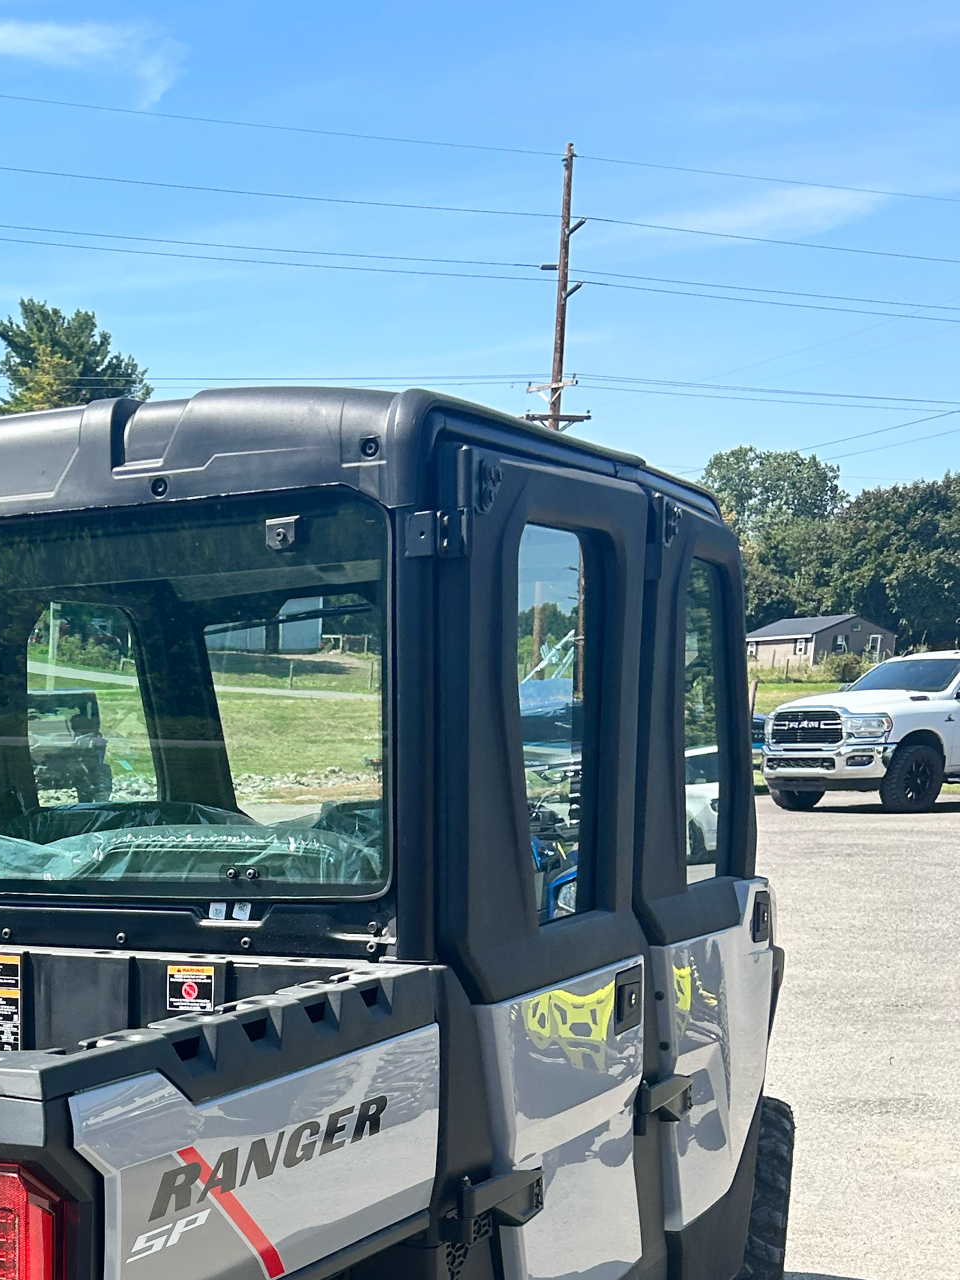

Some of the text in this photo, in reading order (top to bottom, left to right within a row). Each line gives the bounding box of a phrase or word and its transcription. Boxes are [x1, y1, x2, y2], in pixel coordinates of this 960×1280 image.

[788, 720, 819, 729] RAM
[148, 1095, 388, 1222] RANGER
[125, 1208, 211, 1264] SP
